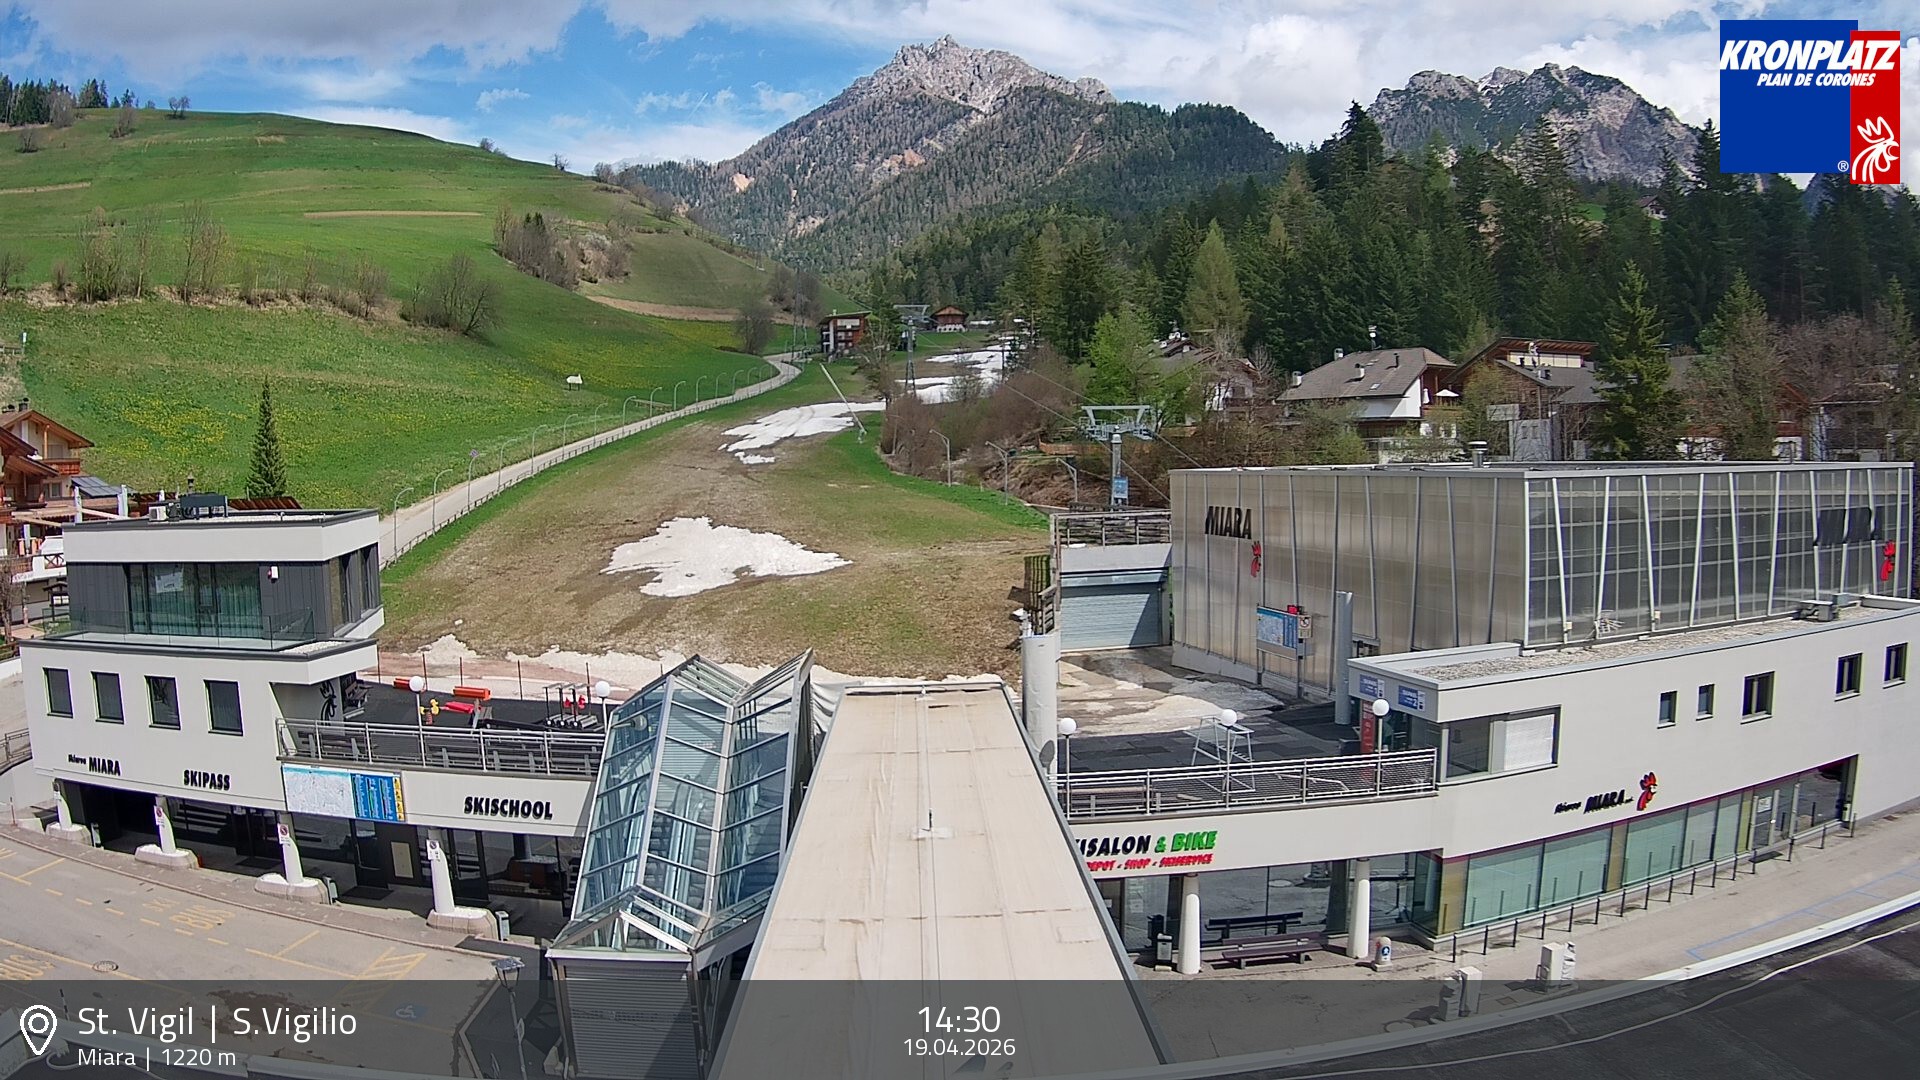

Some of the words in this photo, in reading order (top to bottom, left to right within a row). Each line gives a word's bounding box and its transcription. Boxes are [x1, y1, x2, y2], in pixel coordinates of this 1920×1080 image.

[1204, 505, 1252, 540] MIARA
[88, 756, 121, 776] MIARA
[183, 769, 231, 791] SKIPASS
[463, 796, 553, 820] SKISCHOOL
[1583, 789, 1625, 814] MIARA
[1075, 835, 1152, 857] ISALON
[1154, 836, 1166, 853] &
[1170, 830, 1218, 852] BIKE
[169, 904, 236, 930] BUS
